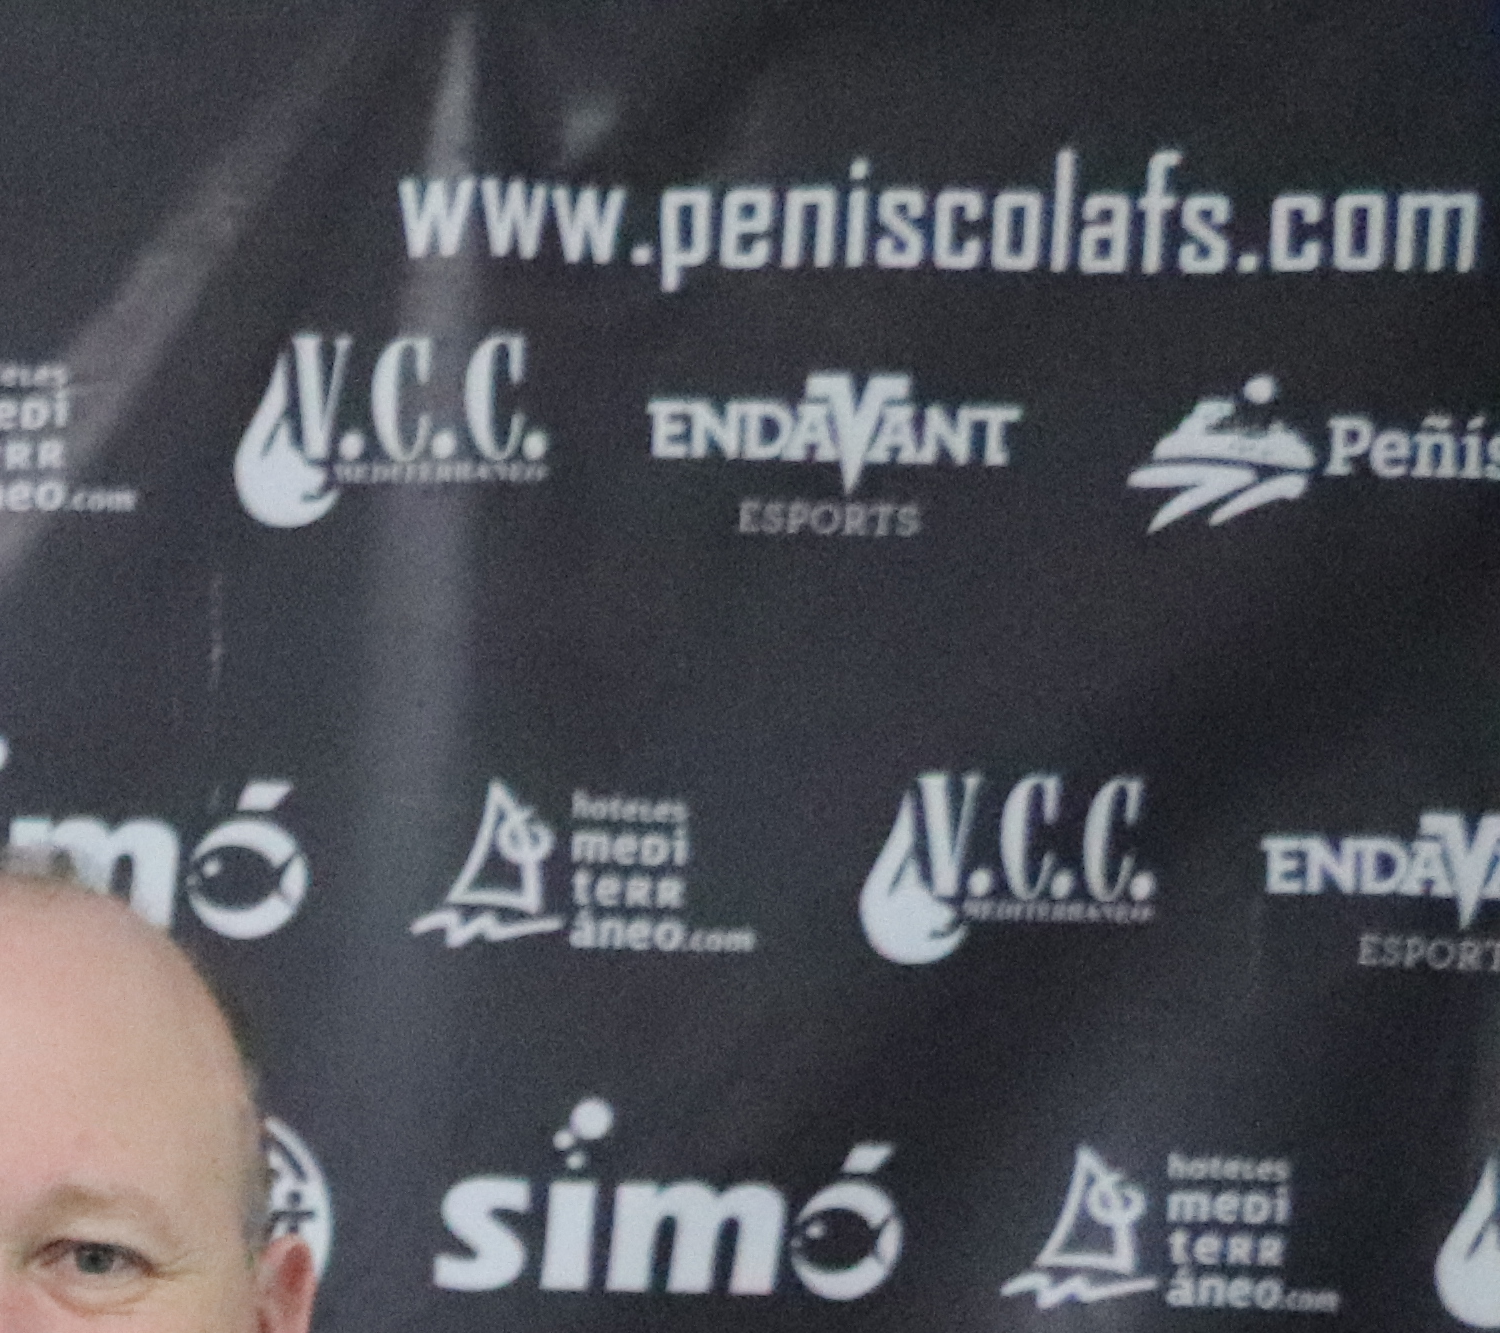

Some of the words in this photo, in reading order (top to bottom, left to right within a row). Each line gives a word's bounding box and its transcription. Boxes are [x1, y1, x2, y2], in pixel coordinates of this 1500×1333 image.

[397, 146, 1481, 292] www.peniscolafs.com
[647, 370, 1022, 496] ENDAVANT
[737, 499, 923, 537] ESPORTS
